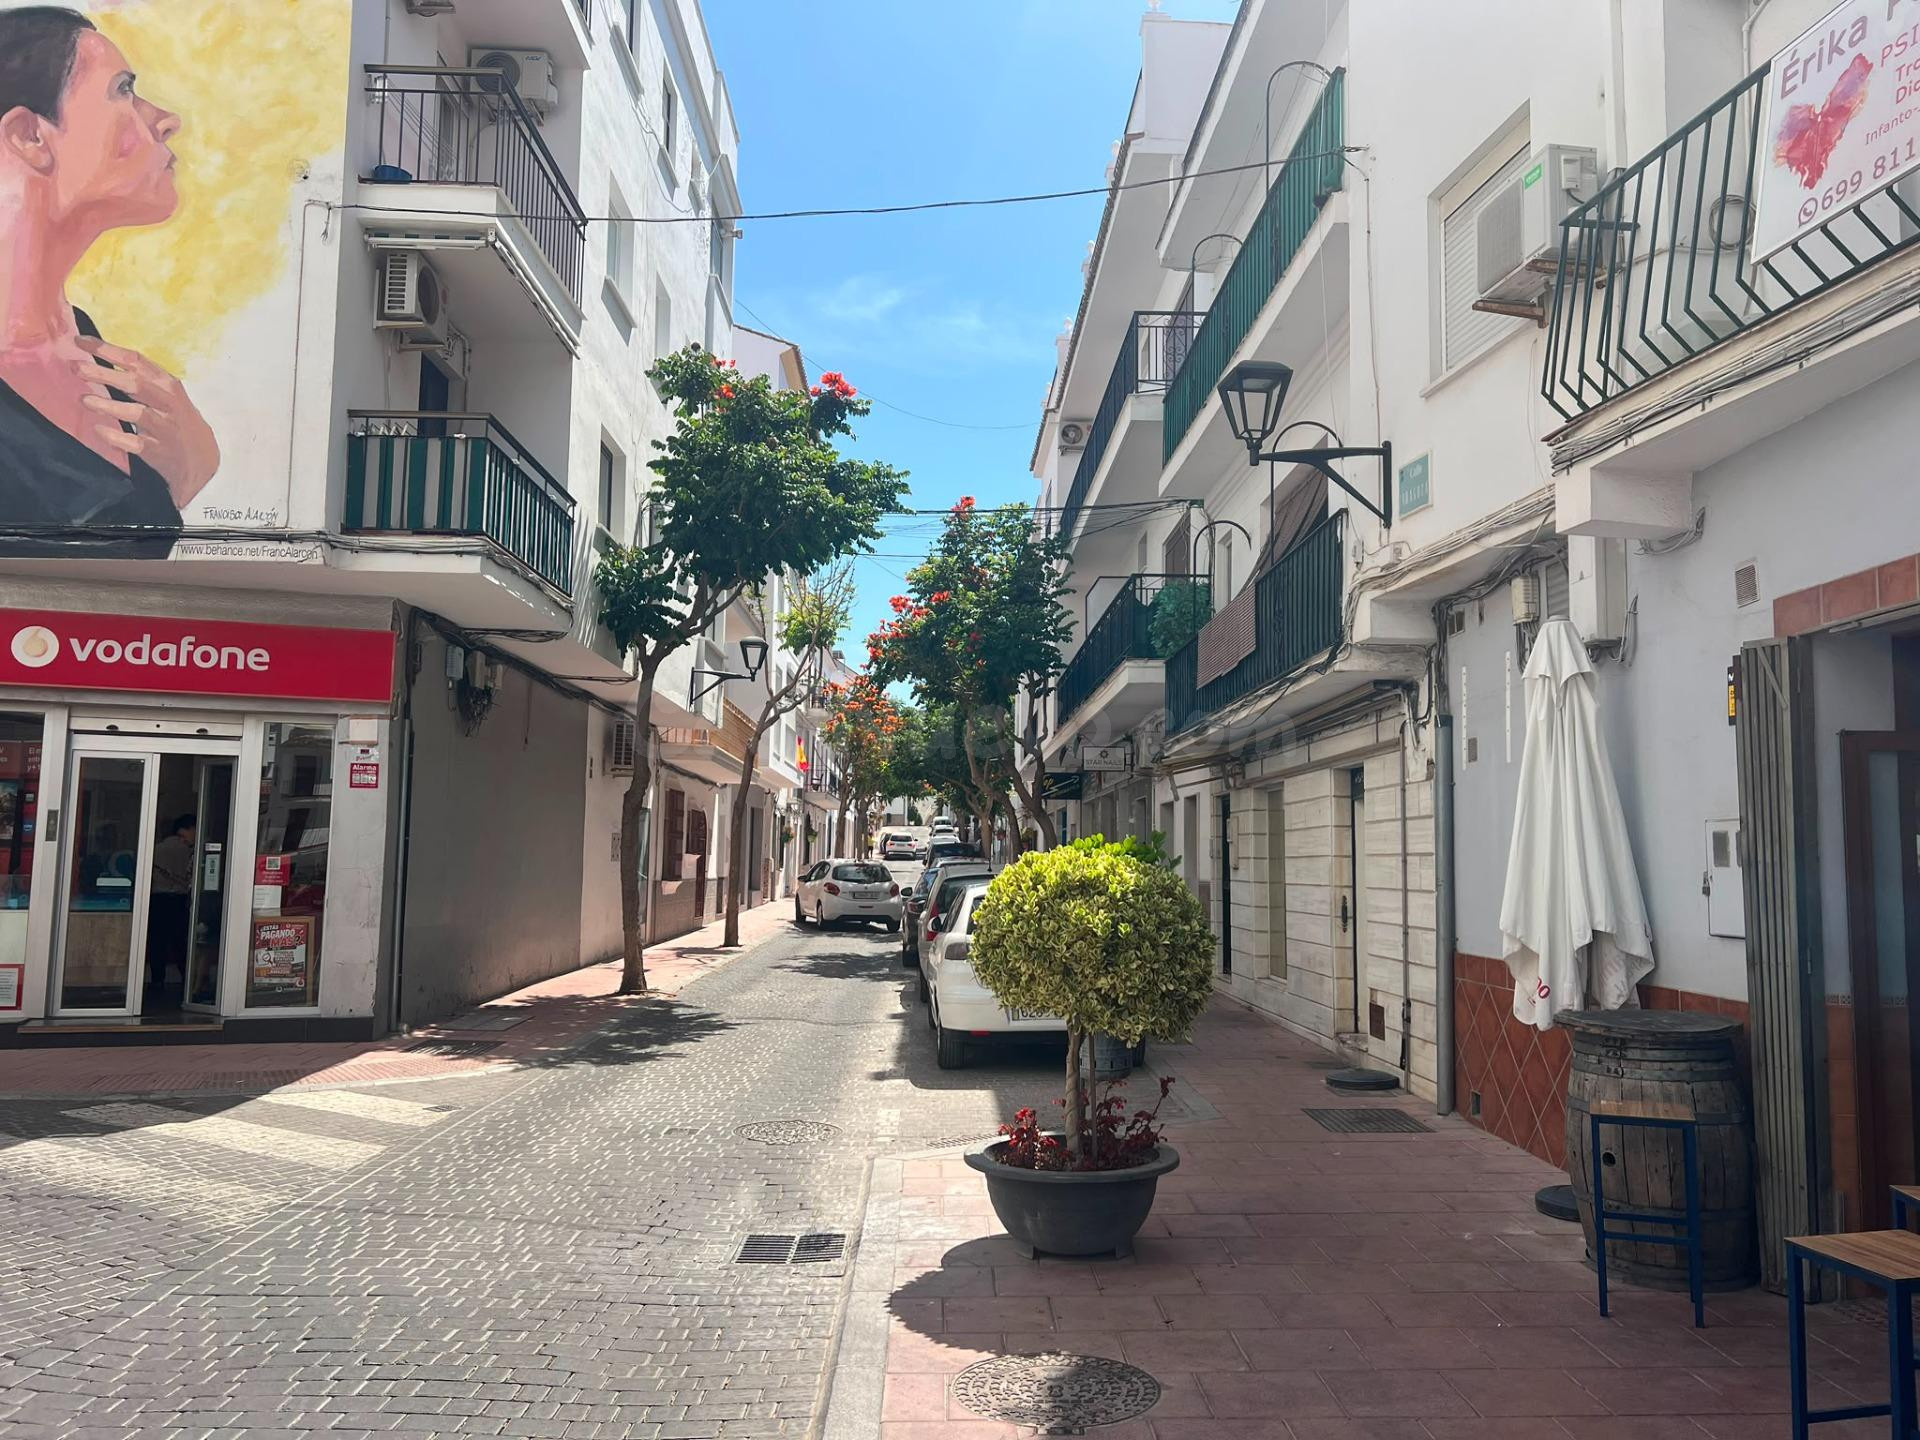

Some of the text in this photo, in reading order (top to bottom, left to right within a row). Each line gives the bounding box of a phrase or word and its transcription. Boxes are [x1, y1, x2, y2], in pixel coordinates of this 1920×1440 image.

[1781, 14, 1868, 100] Érika
[1865, 105, 1920, 146] Infanto-
[1821, 136, 1916, 211] 699 811
[69, 634, 270, 672] vodafone
